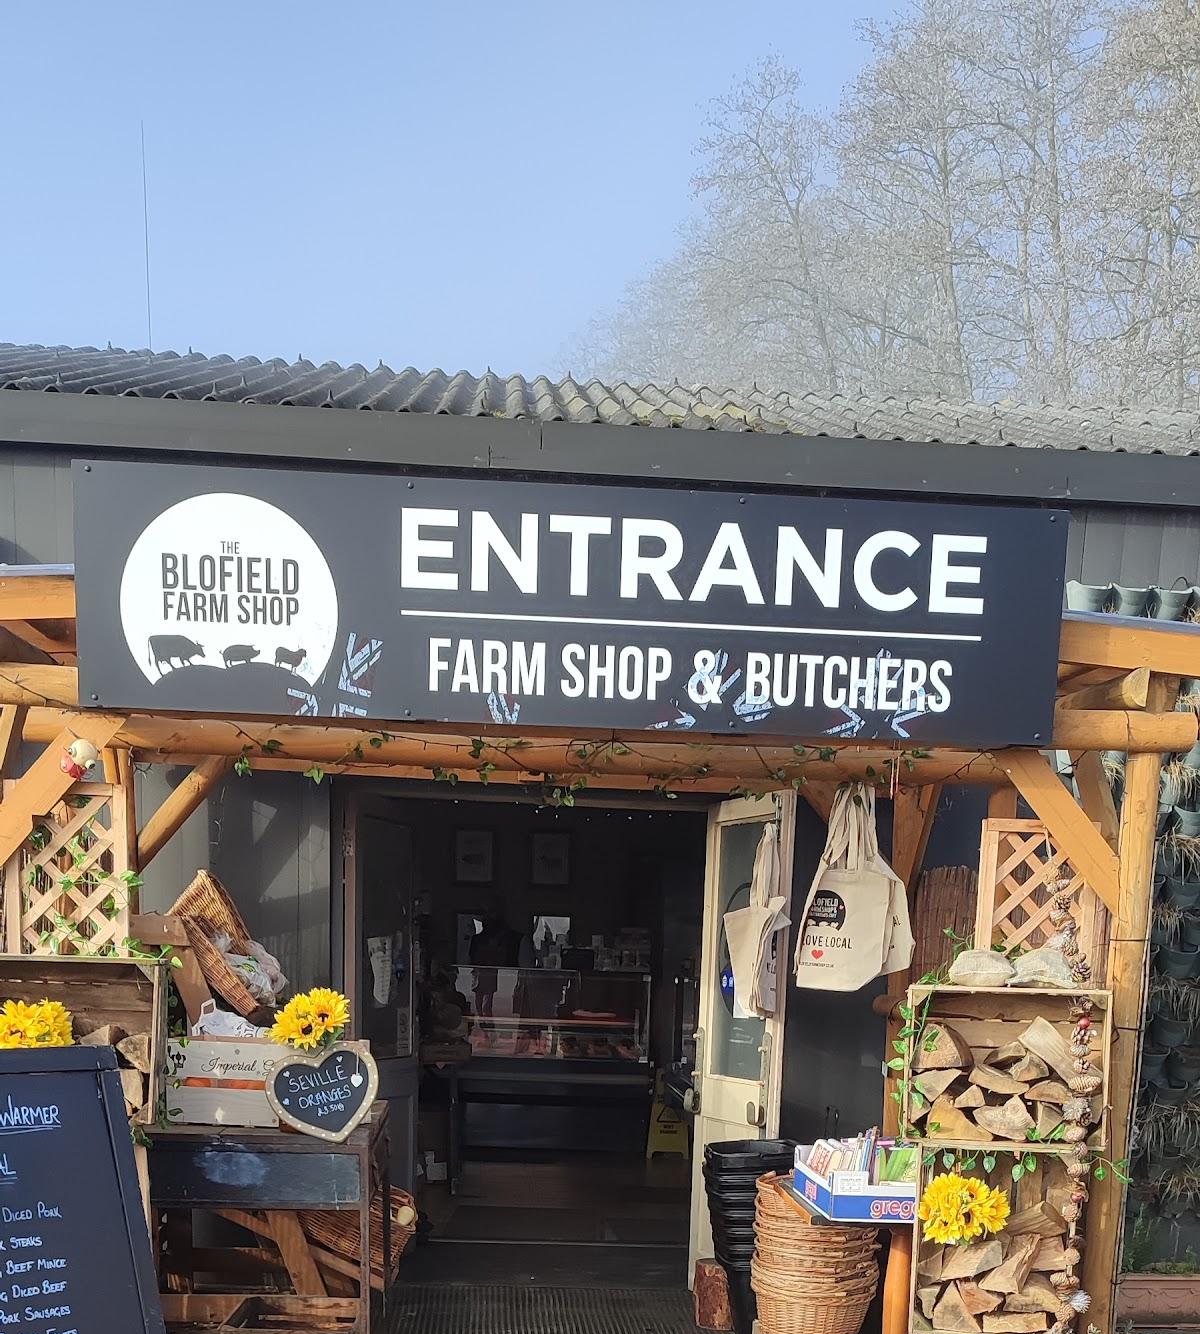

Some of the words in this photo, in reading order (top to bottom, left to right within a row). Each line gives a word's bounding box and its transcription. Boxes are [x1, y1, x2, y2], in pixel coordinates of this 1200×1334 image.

[220, 541, 240, 555] THE
[401, 507, 988, 616] ENTRANCE
[161, 552, 300, 597] BLOFIELD
[163, 591, 230, 625] FARM
[238, 595, 300, 627] SHOP
[428, 637, 546, 697] FARM
[560, 643, 672, 701] SHOP
[687, 649, 723, 706] &
[746, 651, 953, 714] BUTCHERS
[813, 897, 839, 908] LOFIELD
[825, 936, 853, 950] LOCAL
[201, 1056, 258, 1075] Imperial
[289, 1065, 348, 1093] SEVILLE
[299, 1084, 352, 1109] ORANGES
[0, 1095, 62, 1127] WARMER
[2, 1206, 33, 1223] DICED
[870, 1200, 915, 1220] greg
[10, 1236, 43, 1249] STEAKS
[6, 1260, 35, 1275] BEEF
[37, 1258, 67, 1271] MINCE
[42, 1279, 67, 1294] BEEF
[25, 1305, 71, 1321] SAUSAGES
